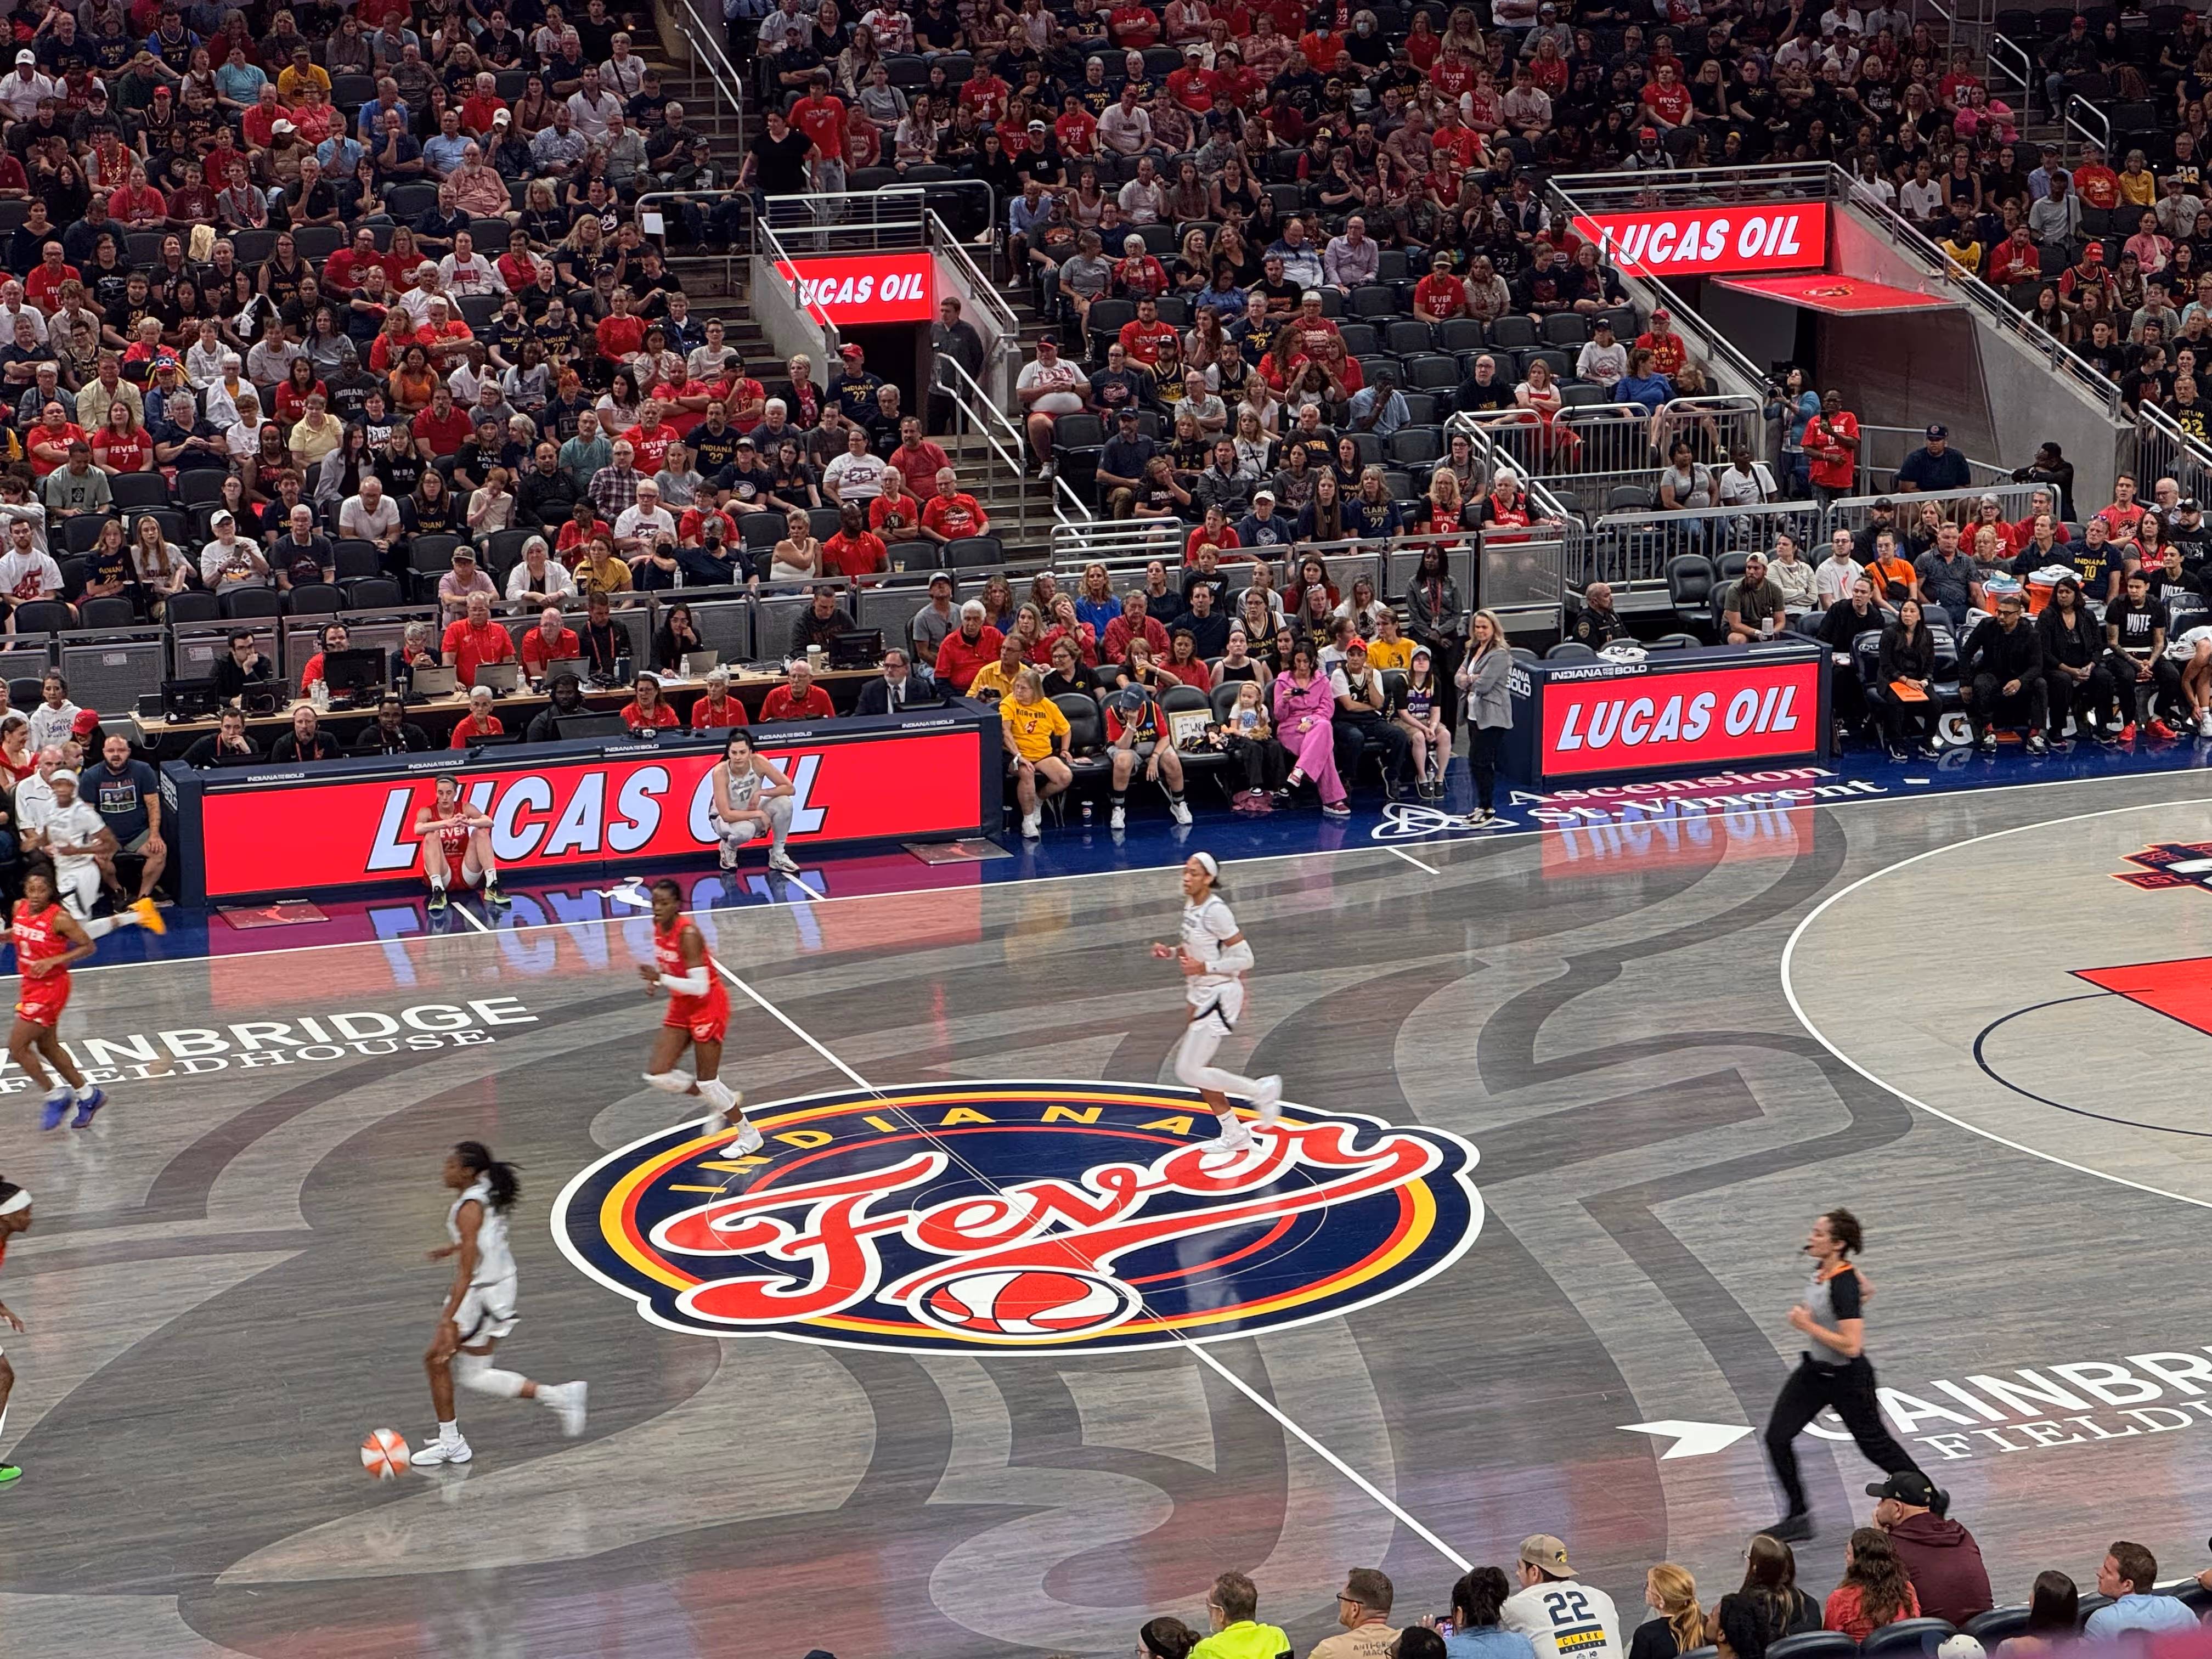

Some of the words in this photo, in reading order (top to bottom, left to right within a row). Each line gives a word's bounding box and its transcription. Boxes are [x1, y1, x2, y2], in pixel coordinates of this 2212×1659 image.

[1449, 79, 1460, 90] 22
[973, 92, 996, 101] FEVER
[1070, 132, 1081, 142] 22
[1012, 138, 1024, 150] 22
[1737, 215, 1801, 259] OIL
[1496, 257, 1509, 266] 22
[787, 275, 874, 307] UCAS
[879, 273, 925, 302] OIL
[1429, 295, 1452, 303] FEVER
[1434, 303, 1447, 315] 22
[553, 342, 566, 353] 22
[842, 385, 874, 393] INDIANA
[853, 391, 866, 403] 22
[366, 424, 392, 441] FEVER
[2181, 417, 2206, 436] 22
[110, 444, 139, 454] FEVER
[640, 439, 668, 449] FEVER
[700, 444, 732, 454] INDIANA
[122, 453, 128, 464] 7
[850, 471, 871, 481] 25
[1362, 506, 1390, 515] CLARK
[1370, 517, 1384, 528] 22
[1441, 523, 1449, 534] 0
[2074, 557, 2107, 566] INDIANA
[2084, 566, 2097, 579] 10
[2161, 583, 2186, 600] VOTE
[2126, 613, 2152, 633] VOTE
[1550, 668, 1602, 681] INDIANA
[1614, 664, 1647, 675] BOLD
[1555, 691, 1716, 752] LUCAS
[1724, 685, 1799, 737] OIL
[605, 744, 634, 753] INDIANA
[408, 760, 438, 770] INDIANA
[247, 774, 278, 782] INDIANA
[1509, 766, 1839, 806] Ascension
[737, 788, 752, 801] 17
[1618, 779, 1888, 815] Vincent
[439, 826, 467, 839] EVER
[443, 838, 461, 851] 22
[0, 996, 540, 1073] AINBRIDGE
[670, 1104, 1195, 1194] INDIANA
[650, 1119, 1446, 1324] Fever
[1543, 1591, 1596, 1627] 22
[1562, 1632, 1599, 1646] CLARK
[1353, 1641, 1392, 1651] ANTI-GR
